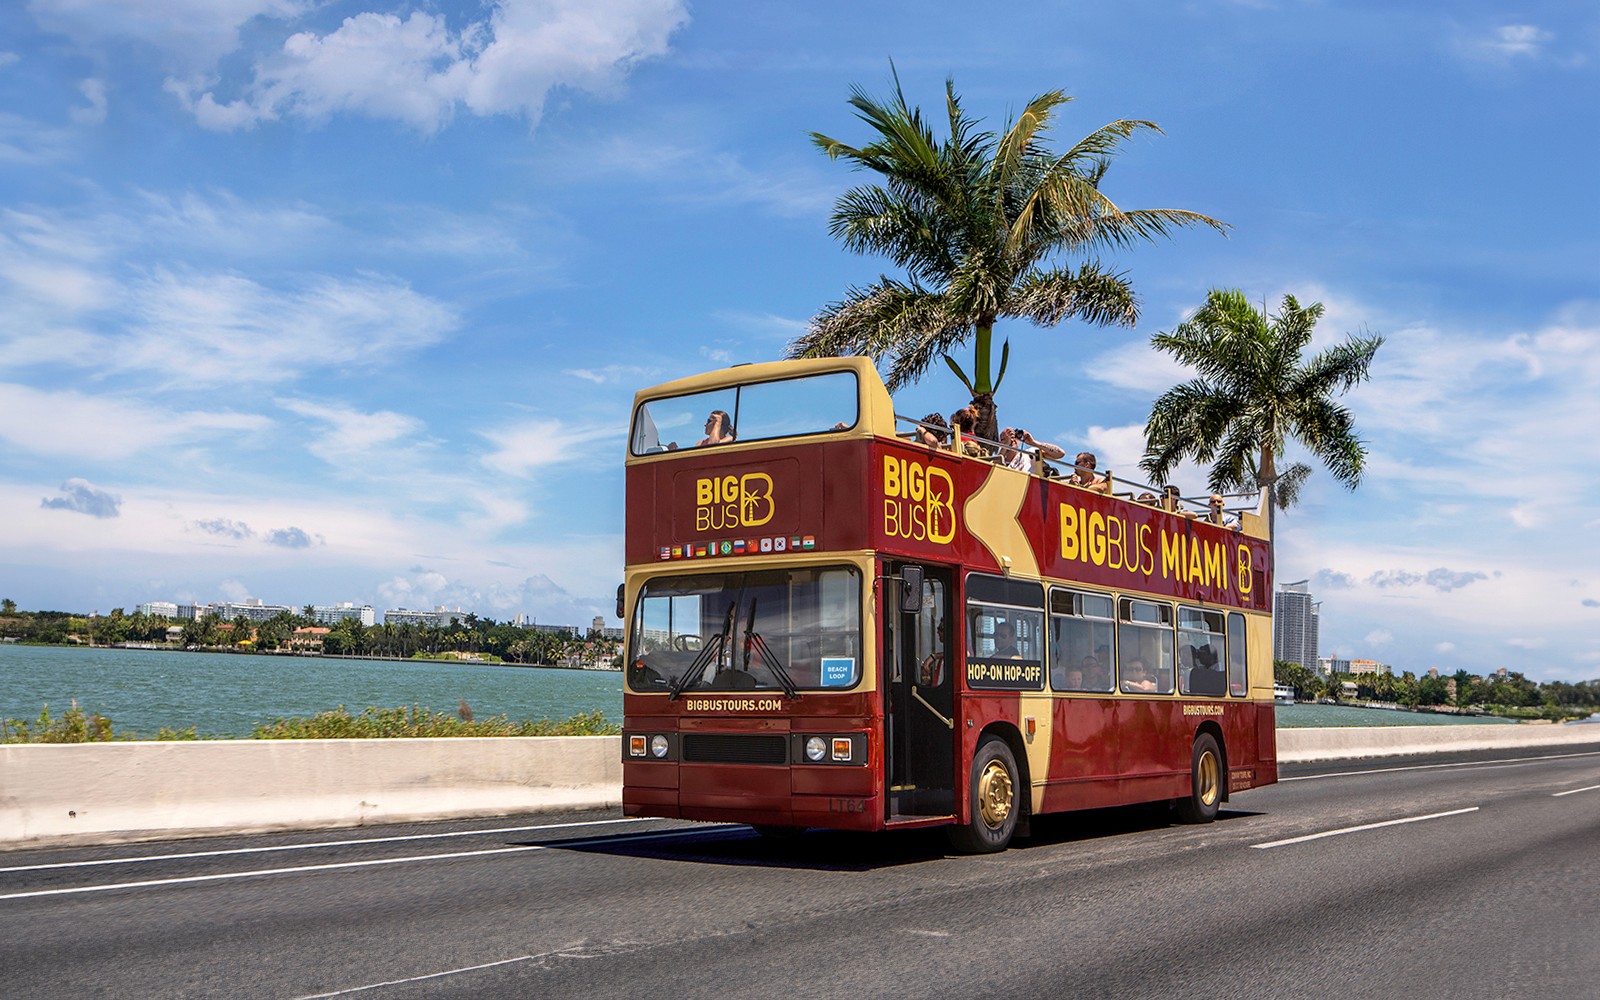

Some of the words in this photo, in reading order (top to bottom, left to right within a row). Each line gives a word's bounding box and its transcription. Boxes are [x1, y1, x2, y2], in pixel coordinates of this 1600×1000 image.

[697, 475, 739, 505] BIG
[884, 455, 925, 502] BIG
[696, 504, 739, 531] BUS
[884, 499, 926, 541] BUS
[1161, 529, 1228, 590] MIAMI
[687, 700, 781, 711] BIGBUSTOURS.COM
[829, 798, 865, 813] LT64
